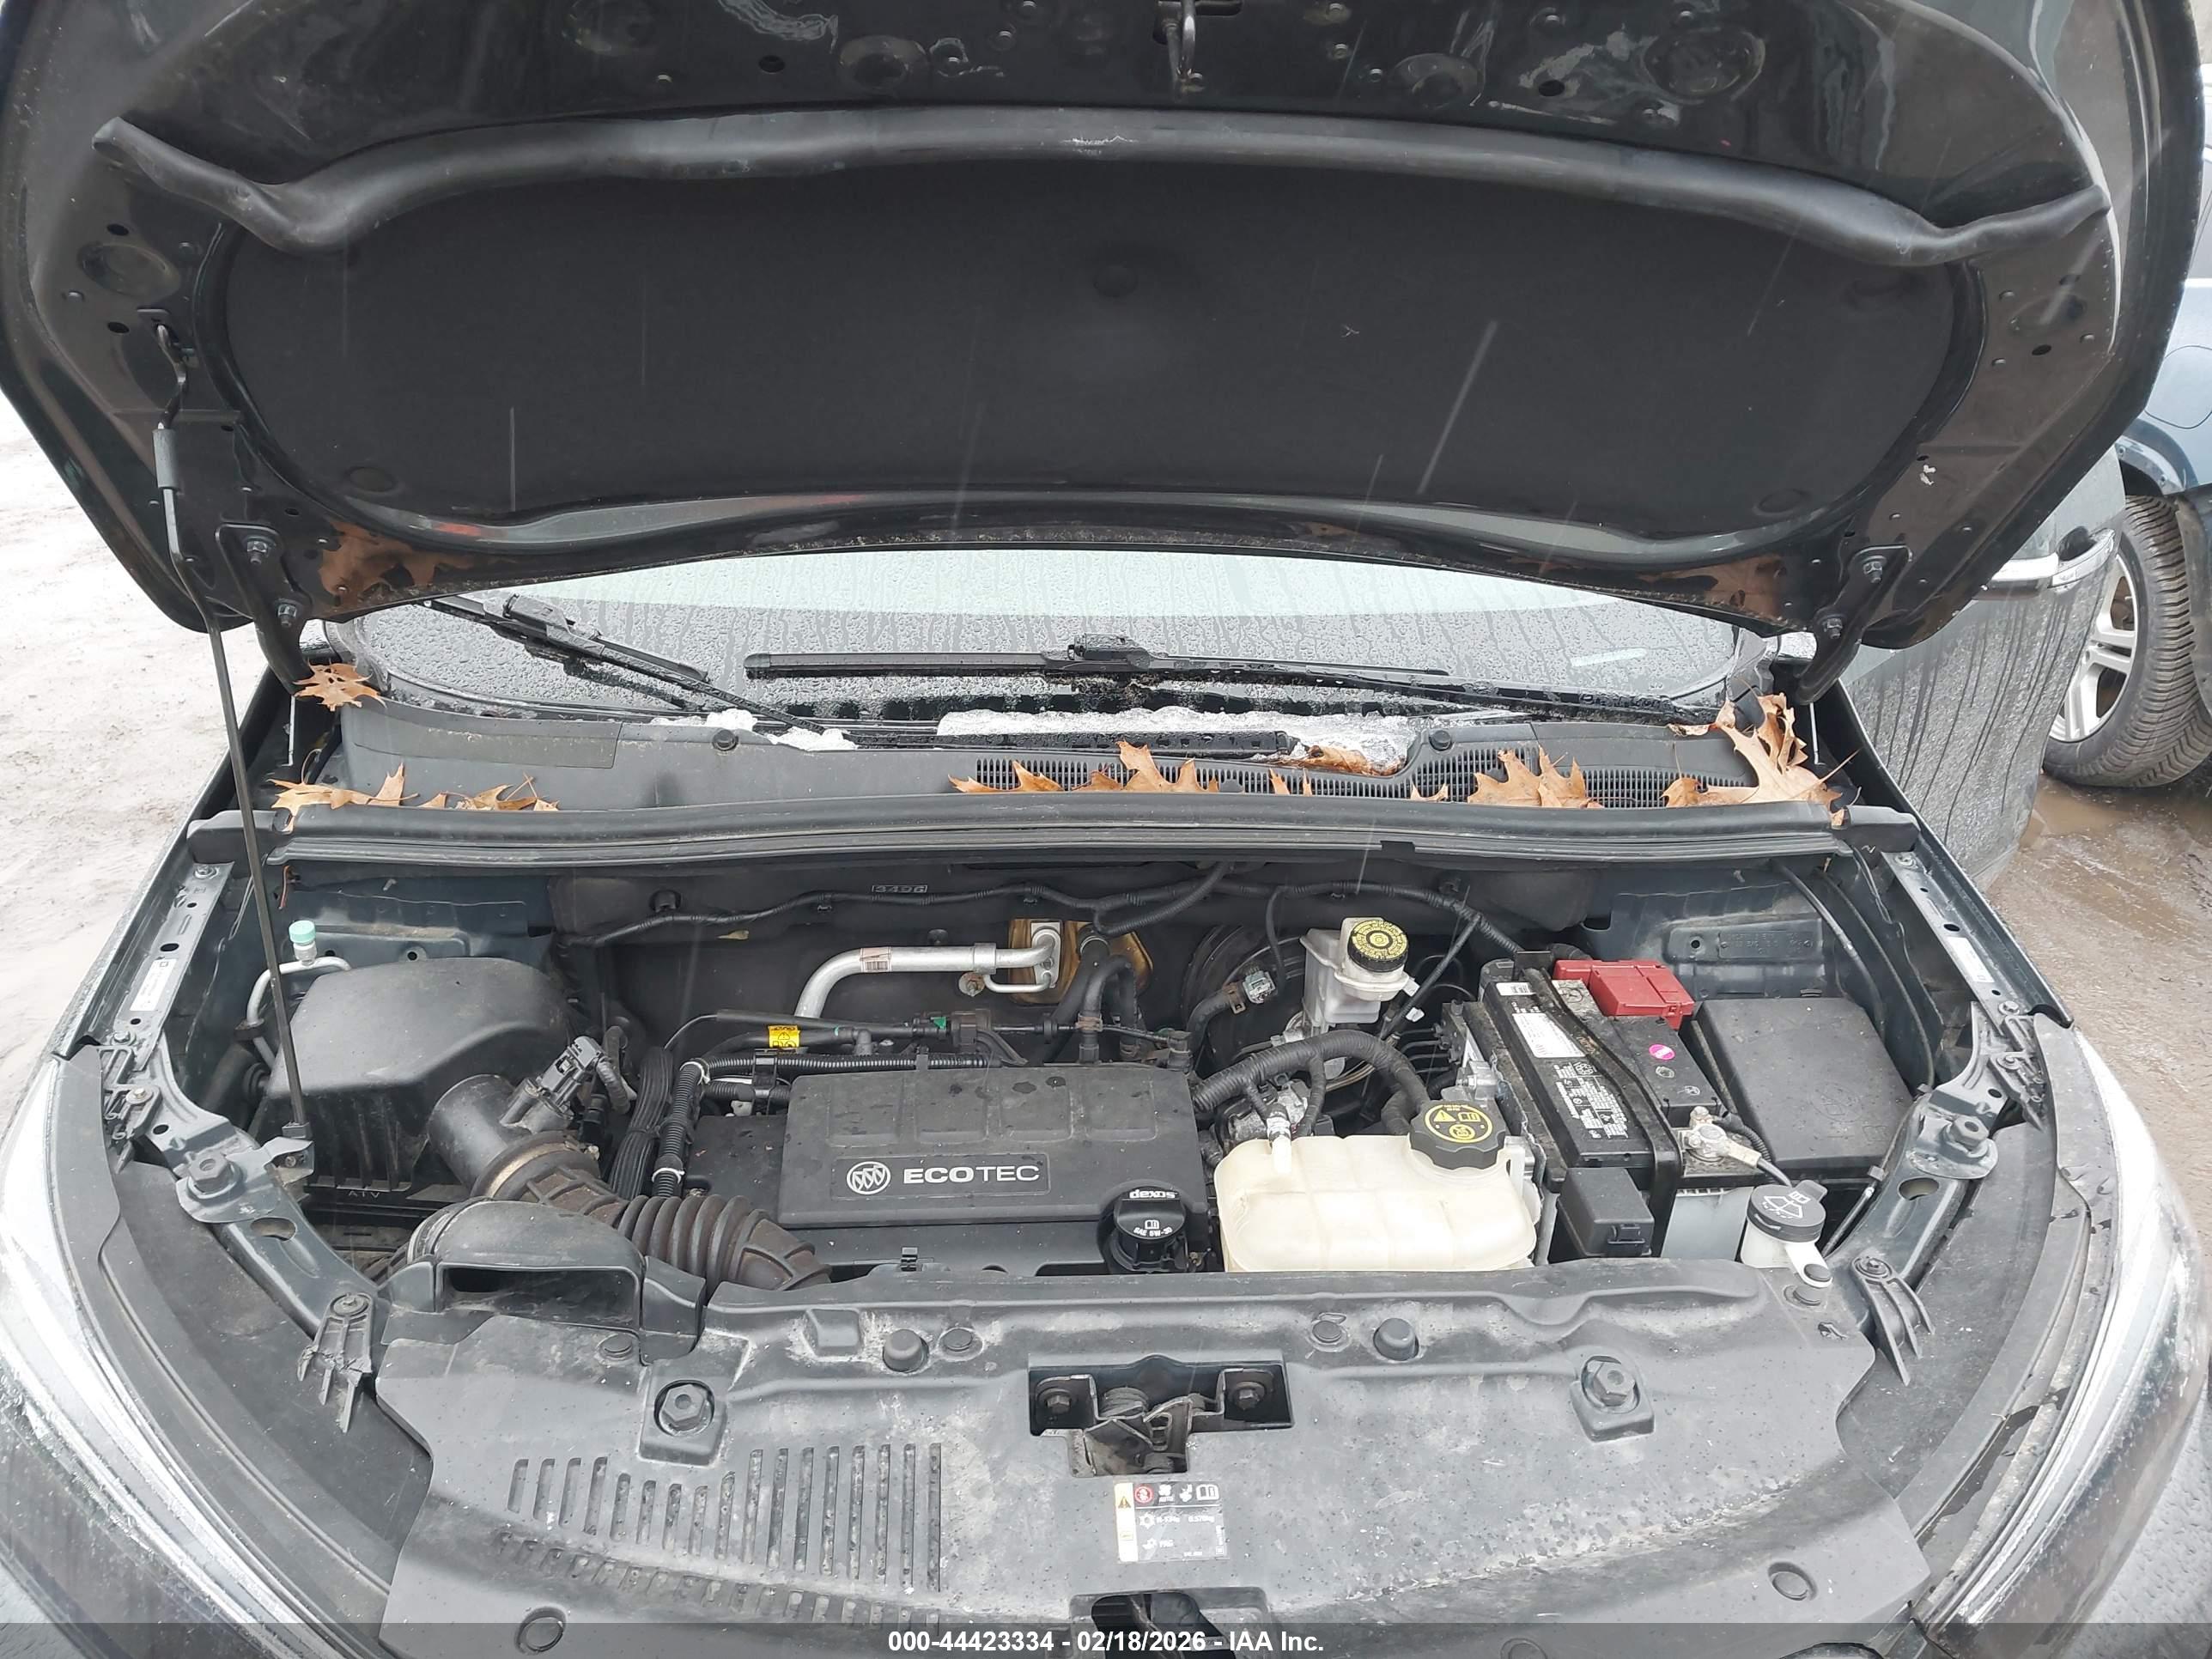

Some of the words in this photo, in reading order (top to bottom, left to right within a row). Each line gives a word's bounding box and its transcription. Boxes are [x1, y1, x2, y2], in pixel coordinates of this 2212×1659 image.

[902, 1165, 1040, 1184] ECOTEC
[1129, 1189, 1176, 1199] dexos
[1133, 1226, 1147, 1237] SAE
